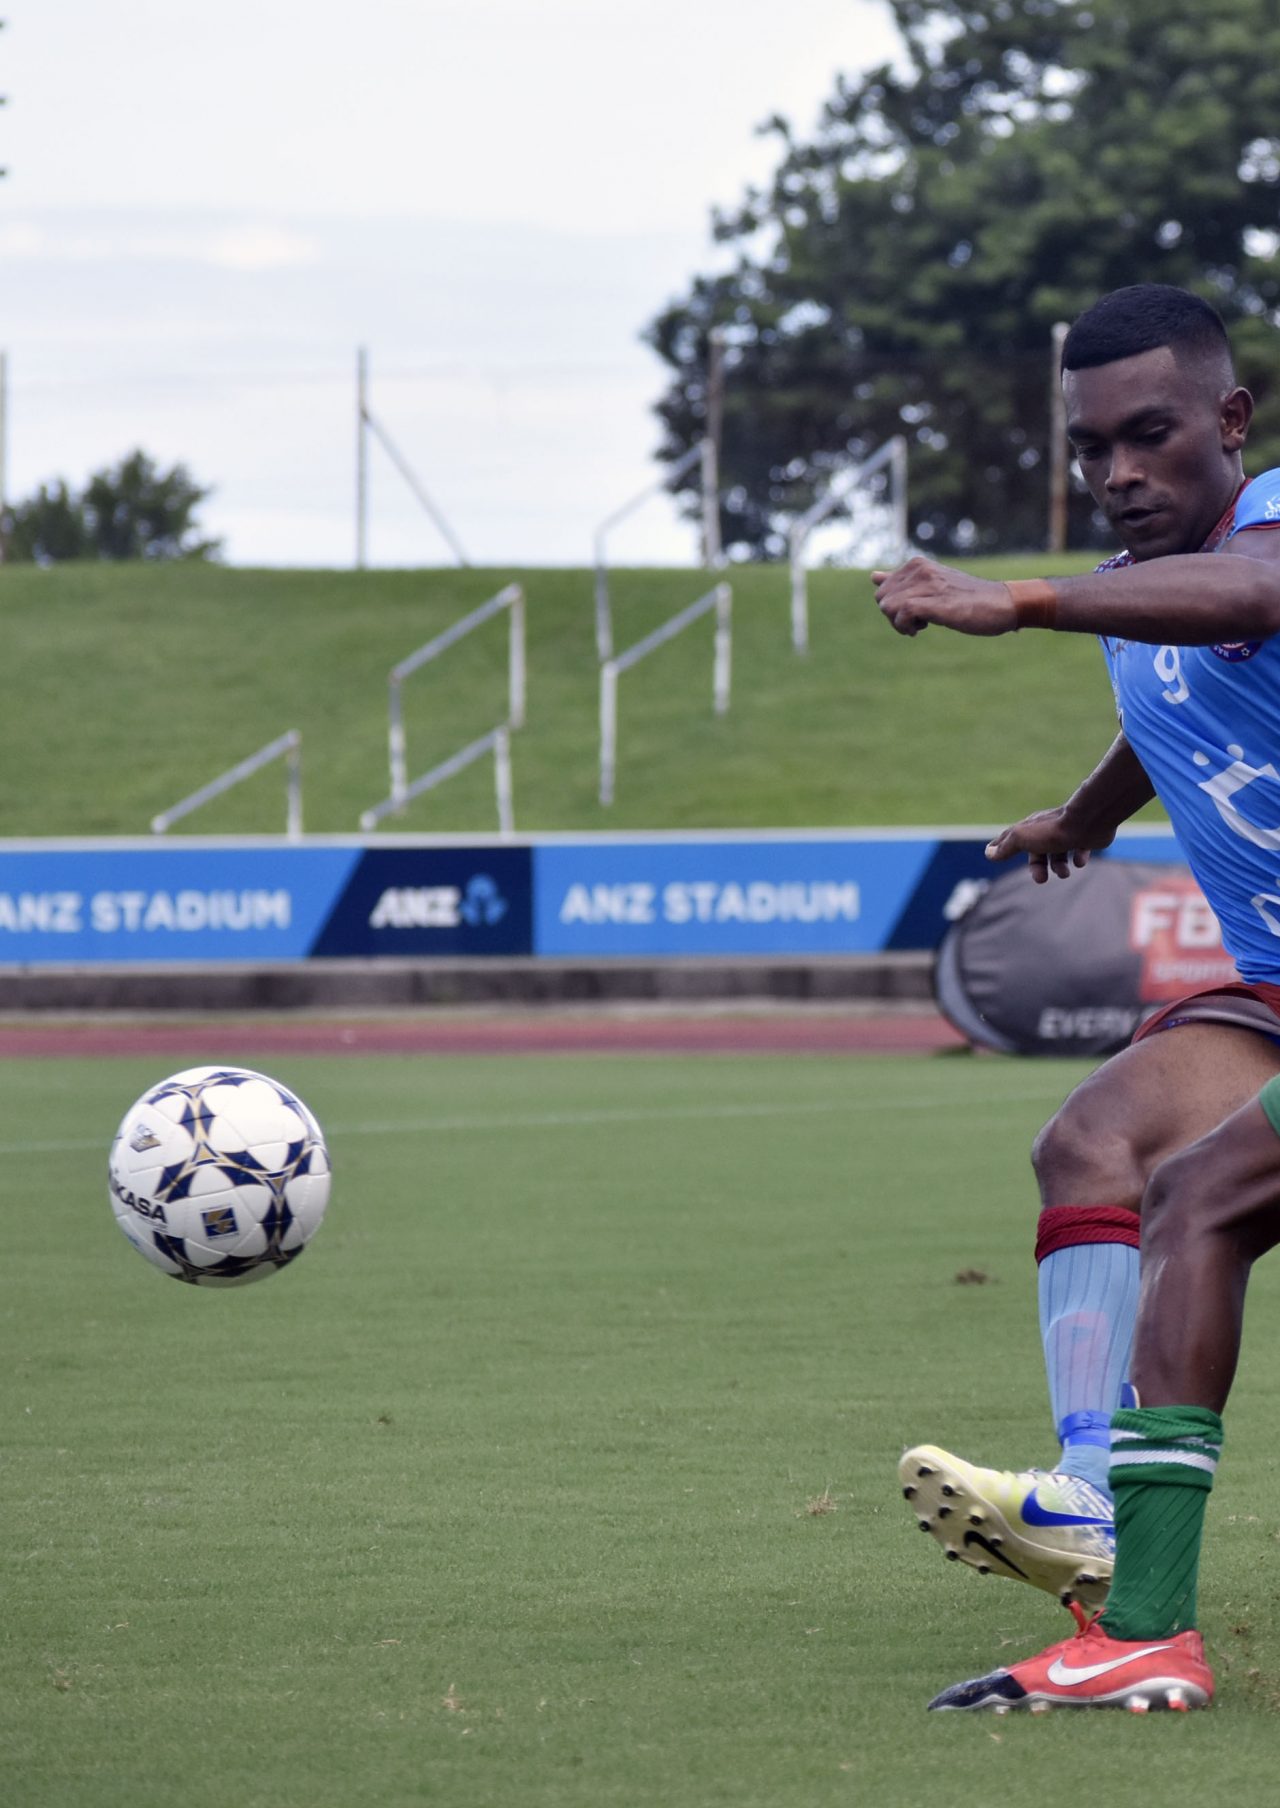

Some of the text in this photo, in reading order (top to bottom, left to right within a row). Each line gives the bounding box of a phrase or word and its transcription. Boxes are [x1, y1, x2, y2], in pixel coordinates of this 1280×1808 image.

[1153, 645, 1190, 704] 9
[0, 888, 291, 932] ANZ STADIUM
[369, 886, 460, 928] ANZ
[560, 880, 861, 924] ANZ STADIUM
[1133, 893, 1221, 948] FB
[1038, 1006, 1154, 1038] EVERY
